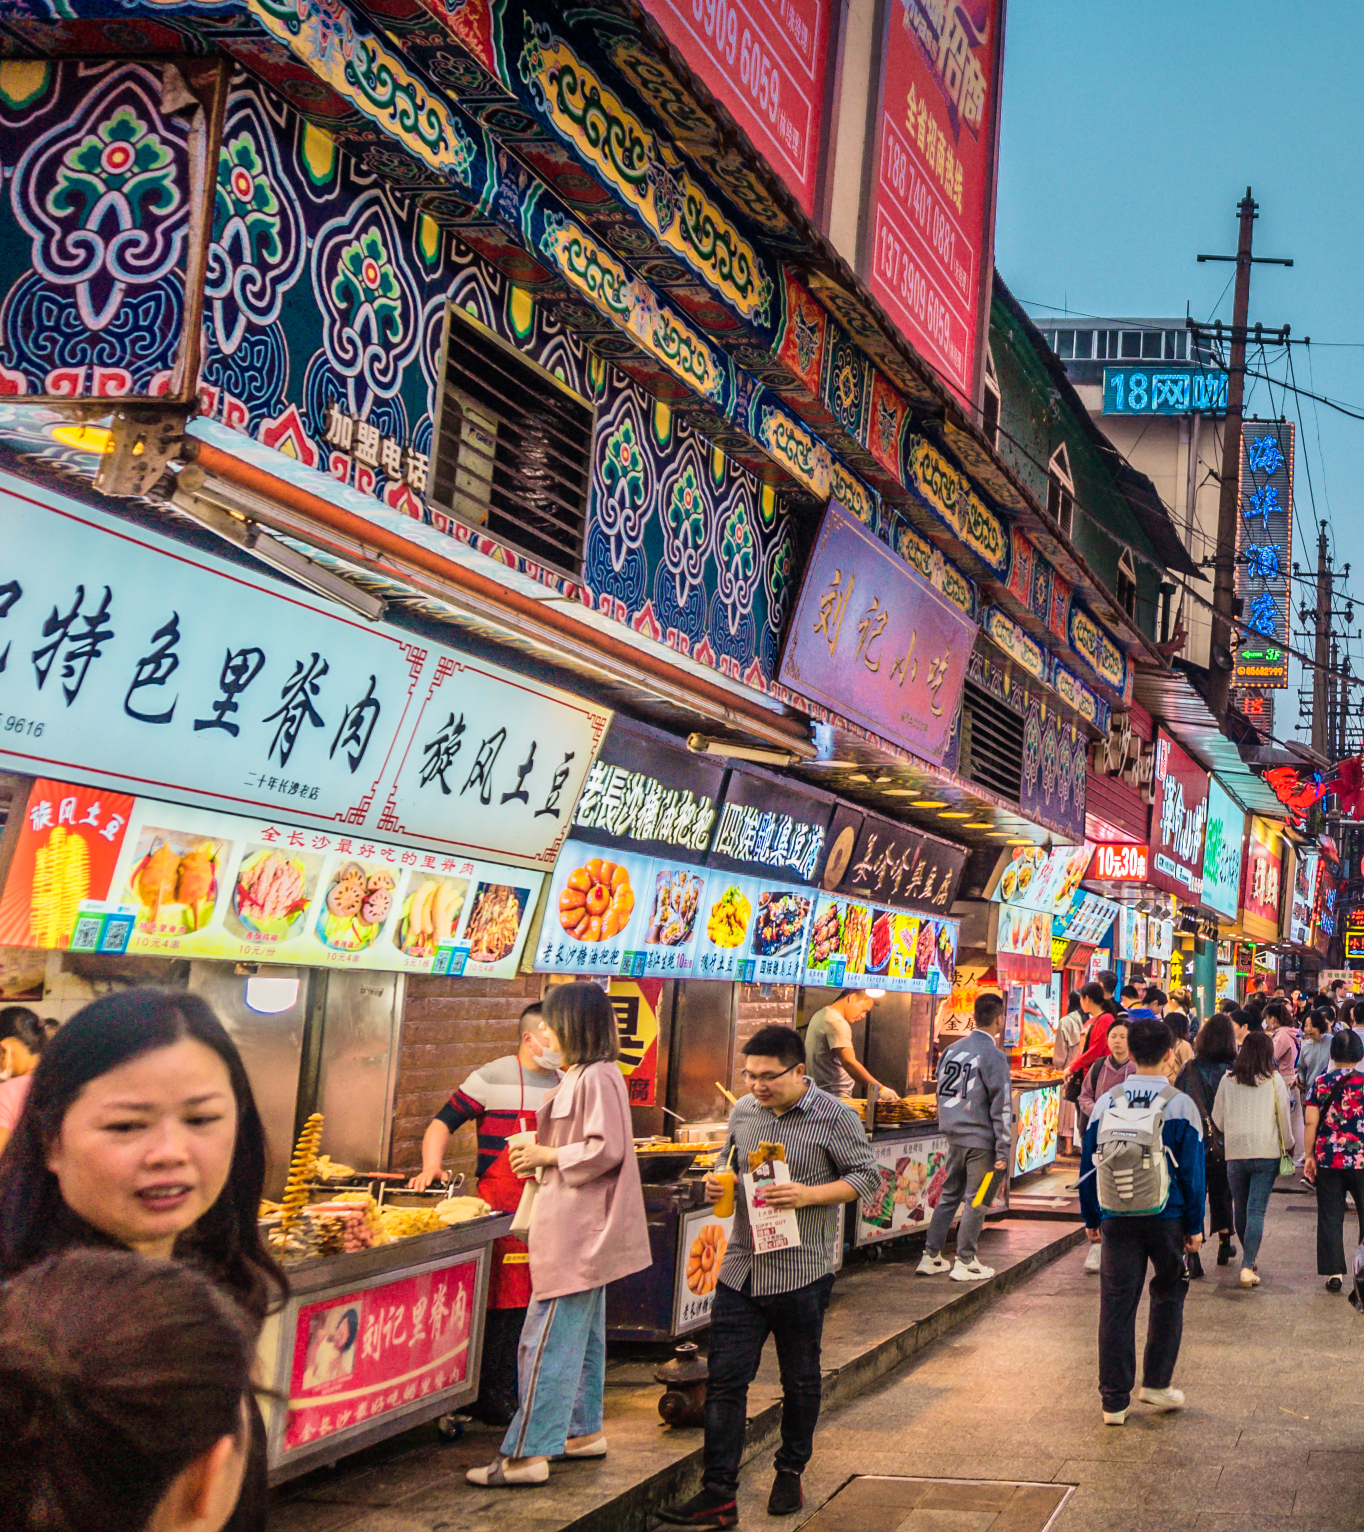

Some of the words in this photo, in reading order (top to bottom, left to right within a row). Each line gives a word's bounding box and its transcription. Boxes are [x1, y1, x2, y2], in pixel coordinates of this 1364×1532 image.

[740, 29, 779, 122] 6059
[906, 81, 963, 215] 全省招商热线
[887, 134, 907, 196] 188
[907, 164, 931, 236] 7401
[932, 206, 955, 271] 0881
[881, 225, 901, 286] 137
[901, 253, 926, 322] 3909
[927, 289, 950, 352] 6059
[326, 402, 429, 492] 加盟电话
[813, 568, 950, 716] 刘记小吃
[1265, 647, 1282, 661] 3F
[4, 716, 45, 738] 9616
[243, 771, 322, 801] 二十年长沙老店
[418, 711, 576, 819] 旋风土豆
[29, 796, 125, 842] 旋风土豆
[260, 826, 475, 876] 全长沙最好吃的里脊肉
[1097, 845, 1146, 878] 10元30串
[134, 936, 181, 950] 10元4串
[326, 952, 361, 963] 10元4串
[939, 1060, 973, 1099] 21
[361, 1281, 467, 1361] 刘记里脊肉
